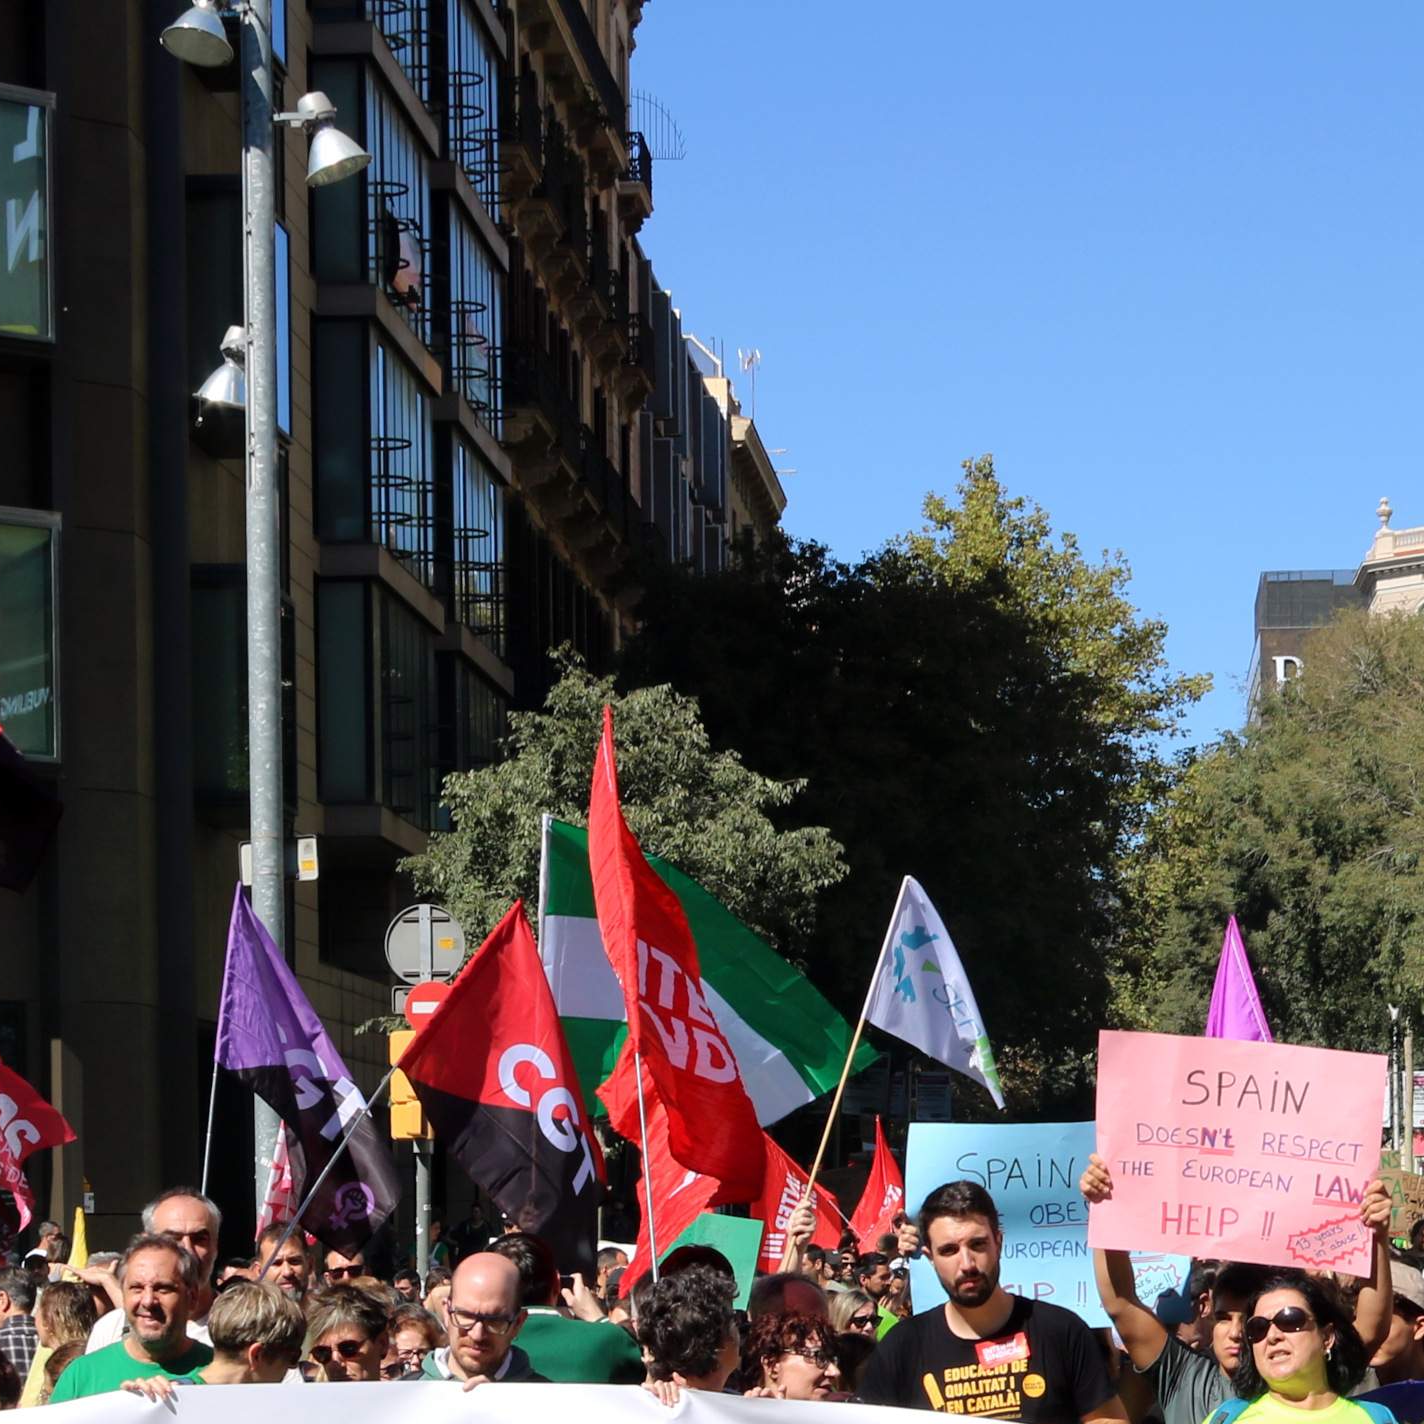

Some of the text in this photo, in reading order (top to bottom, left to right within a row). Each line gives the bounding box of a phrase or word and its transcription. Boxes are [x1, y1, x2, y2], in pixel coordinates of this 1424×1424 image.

[1261, 1131, 1364, 1163] RESPECT
[1117, 1160, 1155, 1177] THE
[1182, 1159, 1294, 1193] EUROPEAN
[1315, 1174, 1369, 1204] LAW
[1161, 1202, 1275, 1241] HELP !!
[1312, 1248, 1327, 1259] in
[1330, 1233, 1358, 1251] abuse
[1314, 1225, 1345, 1247] years
[1001, 1240, 1089, 1261] UROPEAN
[1010, 1359, 1029, 1374] DE
[944, 1377, 1008, 1399] QUALITAT
[1009, 1377, 1016, 1390] I
[946, 1388, 1021, 1415] EN CATALÀ!
